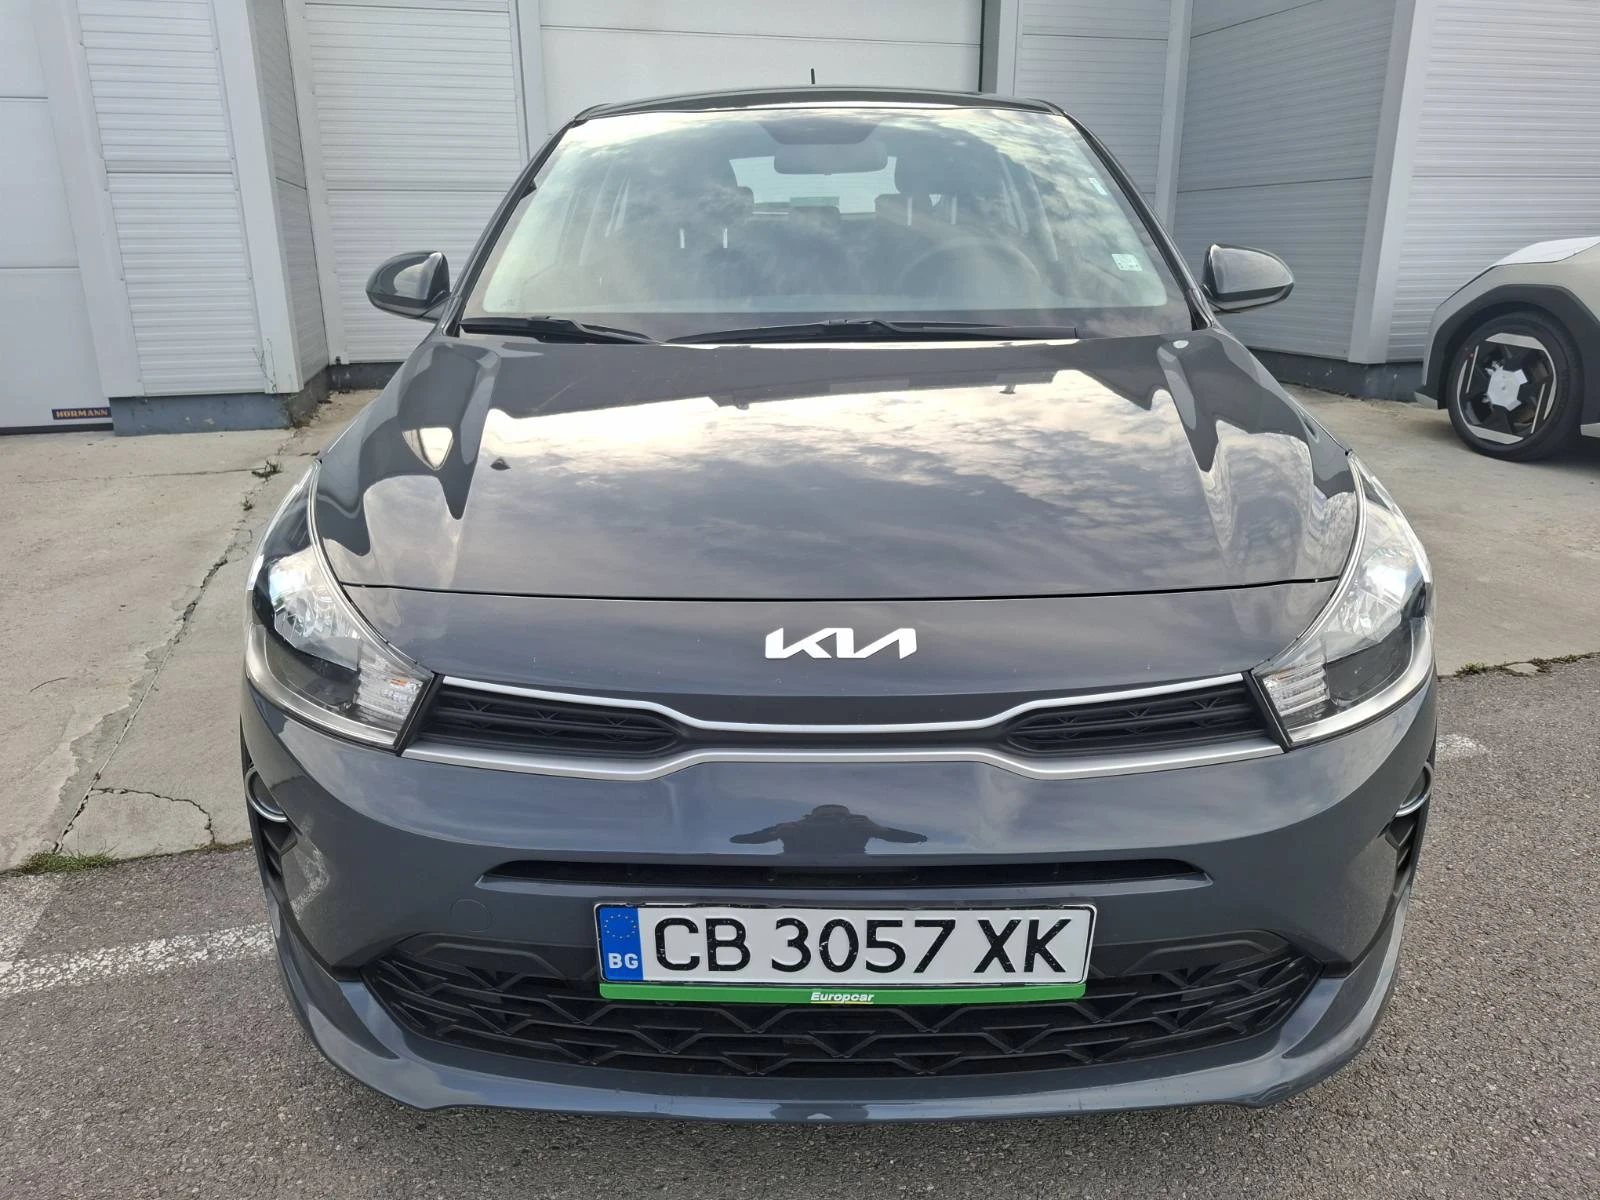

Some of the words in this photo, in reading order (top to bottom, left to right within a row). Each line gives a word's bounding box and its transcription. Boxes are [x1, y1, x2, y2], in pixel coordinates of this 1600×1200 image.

[765, 628, 917, 659] KIA
[654, 917, 751, 972] CB
[771, 918, 956, 974] 3057
[973, 919, 1072, 974] XK
[608, 952, 639, 969] BG
[810, 991, 875, 1004] Europcar
